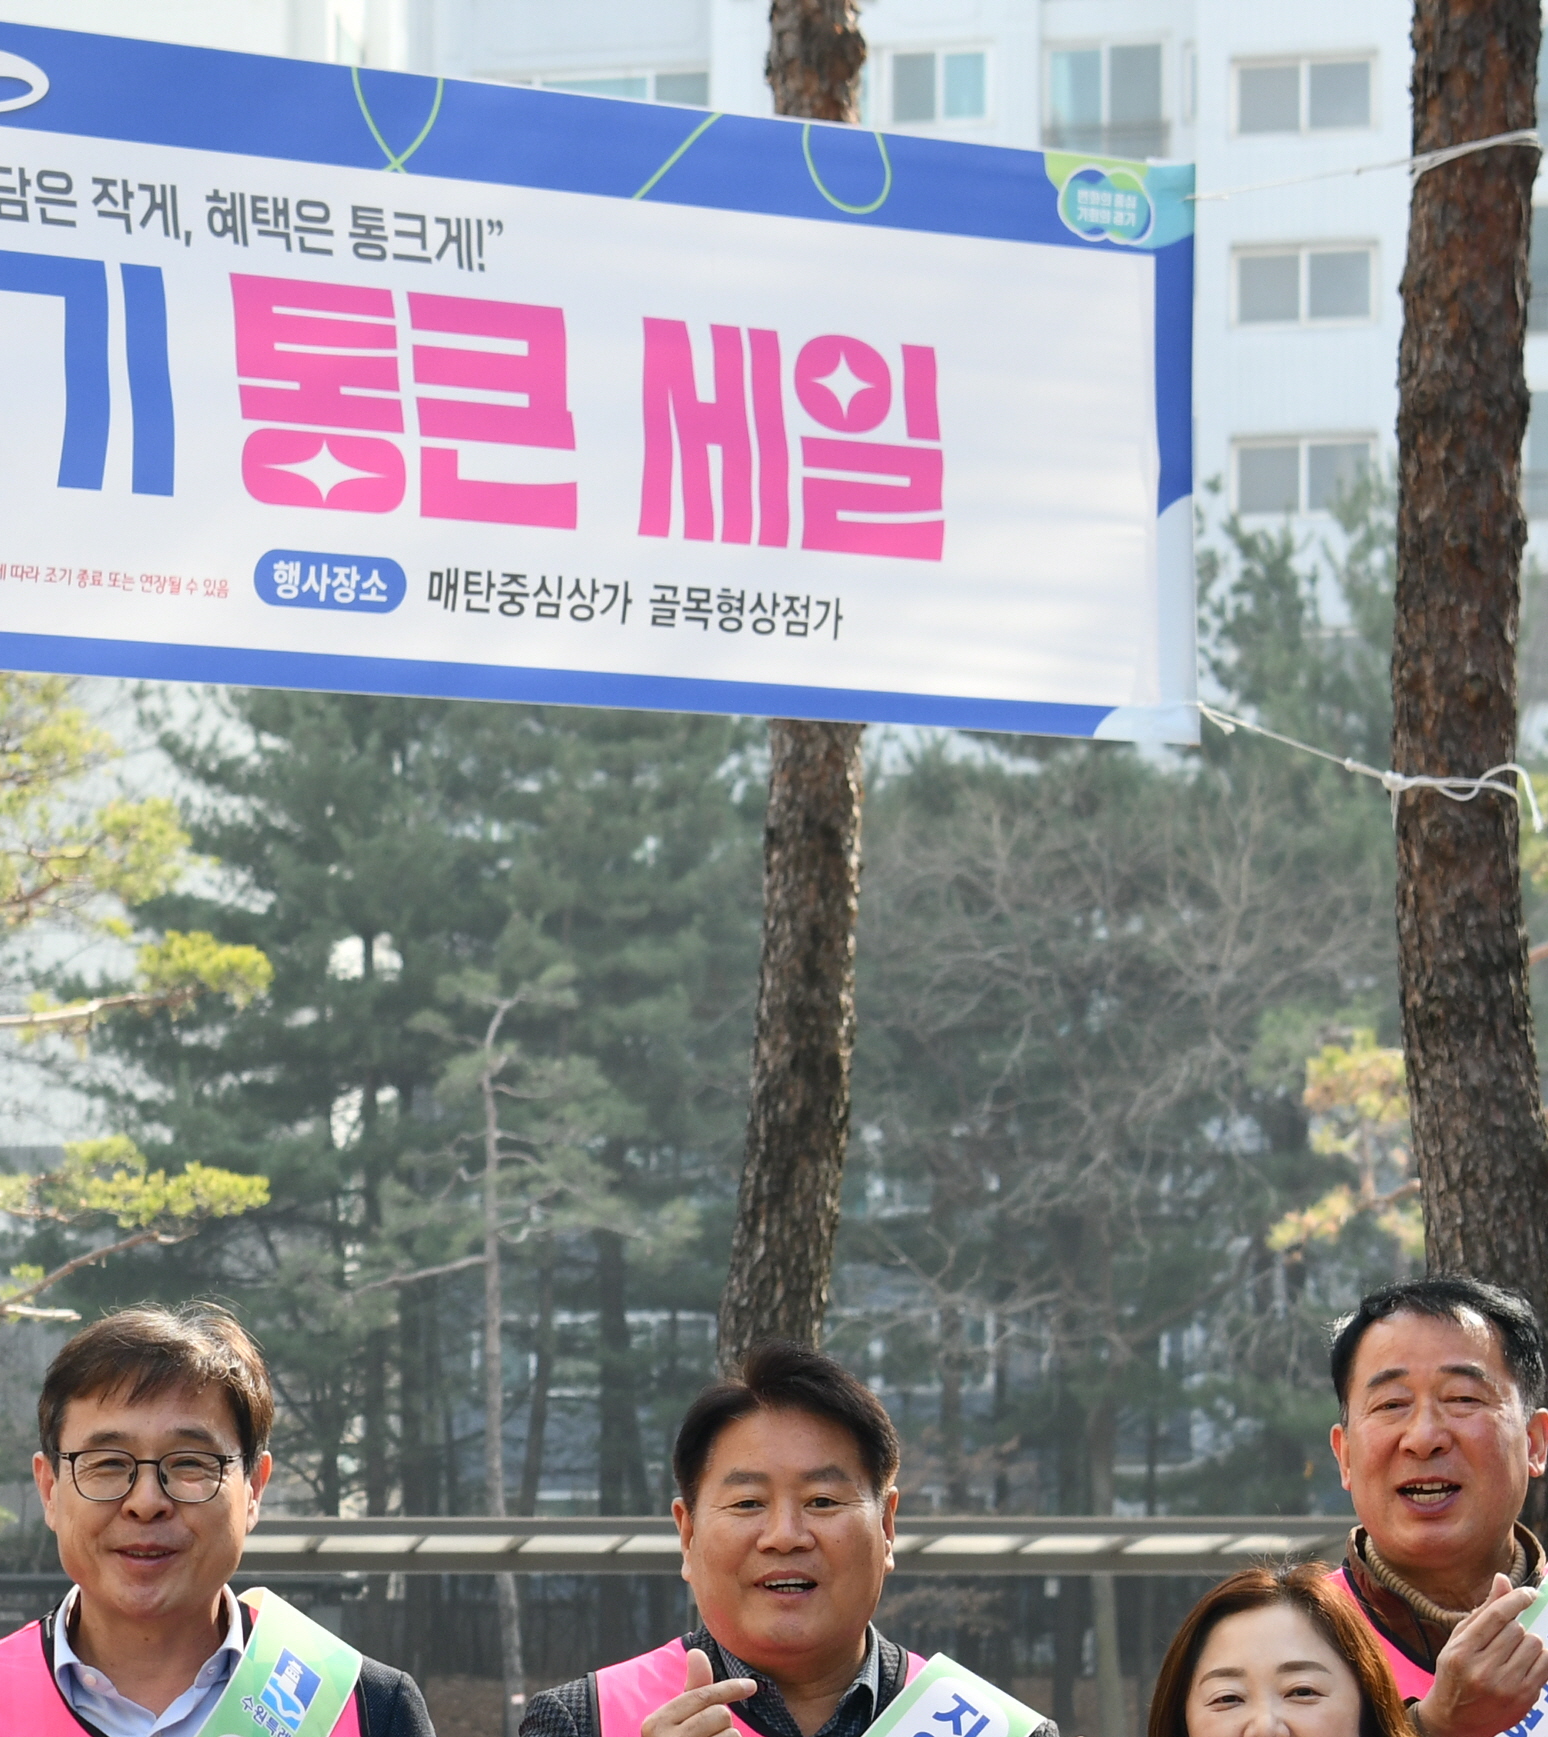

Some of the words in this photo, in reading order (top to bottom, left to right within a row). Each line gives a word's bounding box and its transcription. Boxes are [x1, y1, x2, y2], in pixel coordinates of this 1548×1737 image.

[91, 176, 193, 247] 작게,
[205, 188, 334, 256] 혜택은
[348, 205, 504, 272] 통크게!”
[230, 272, 578, 530] 통큰
[638, 316, 946, 562] 세일
[11, 563, 40, 583] 따라
[44, 567, 72, 586] 조기
[76, 568, 104, 589] 종료
[108, 571, 135, 592] 또는
[185, 578, 199, 596] 수
[204, 579, 230, 599] 있음
[273, 559, 389, 604] 행사장소
[427, 567, 633, 625] 매탄중심상가
[649, 584, 844, 640] 골목형상점가
